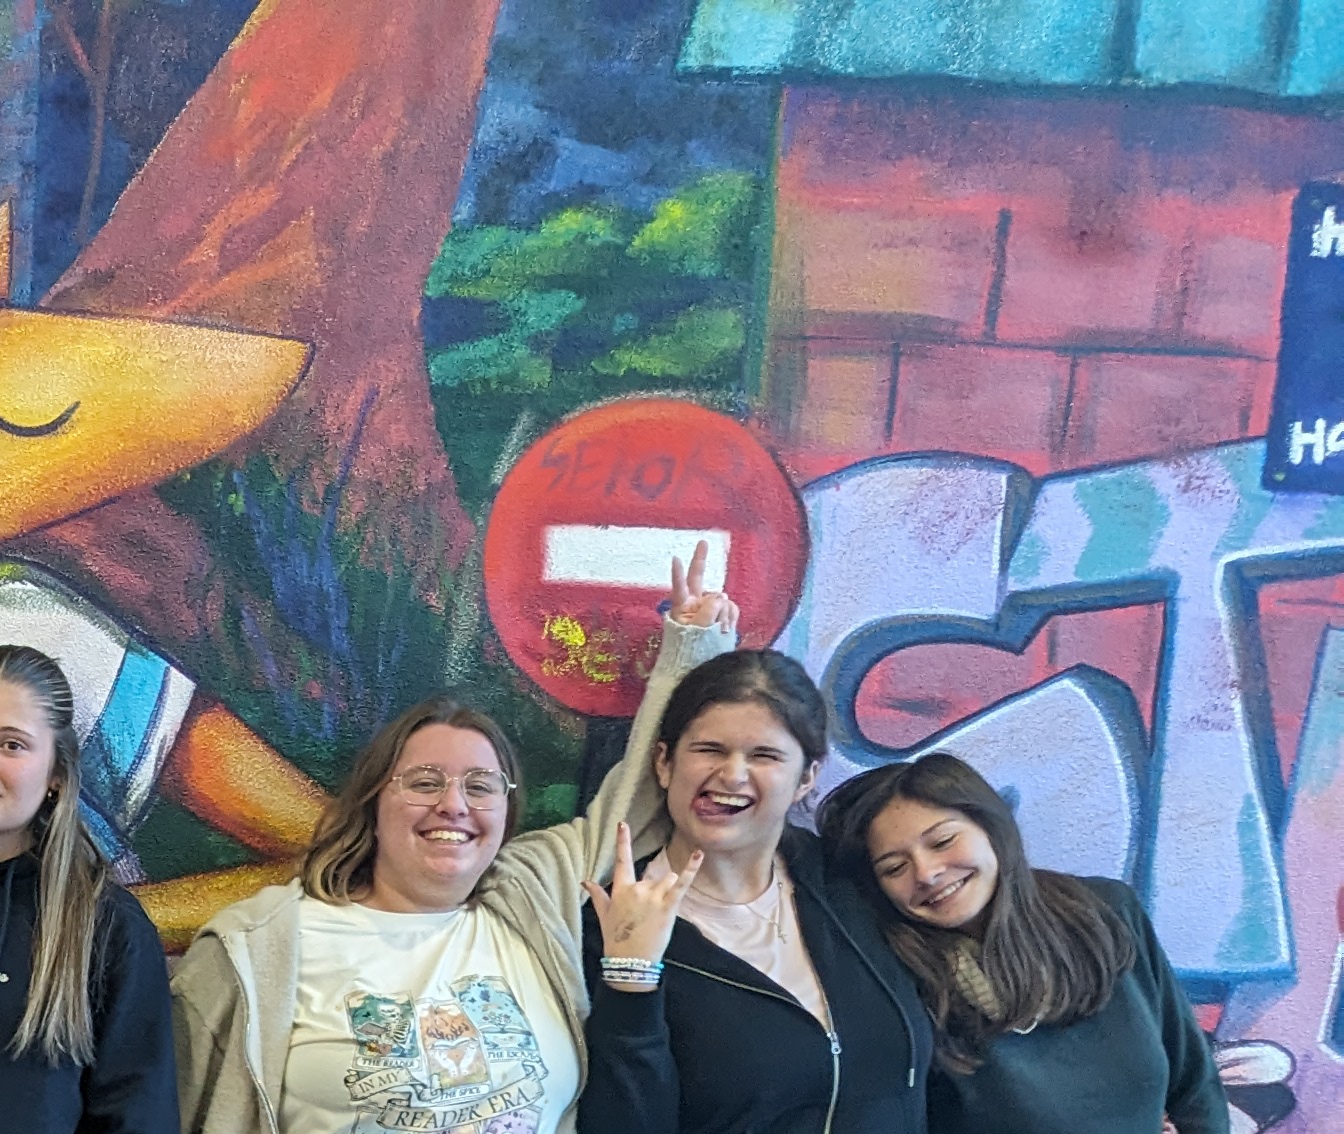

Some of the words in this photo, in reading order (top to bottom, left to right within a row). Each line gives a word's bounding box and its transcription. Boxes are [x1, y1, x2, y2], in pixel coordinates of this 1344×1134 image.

[358, 1079, 375, 1093] IN
[377, 1070, 400, 1087] MY
[394, 1103, 483, 1129] READER
[487, 1086, 531, 1114] ERA
